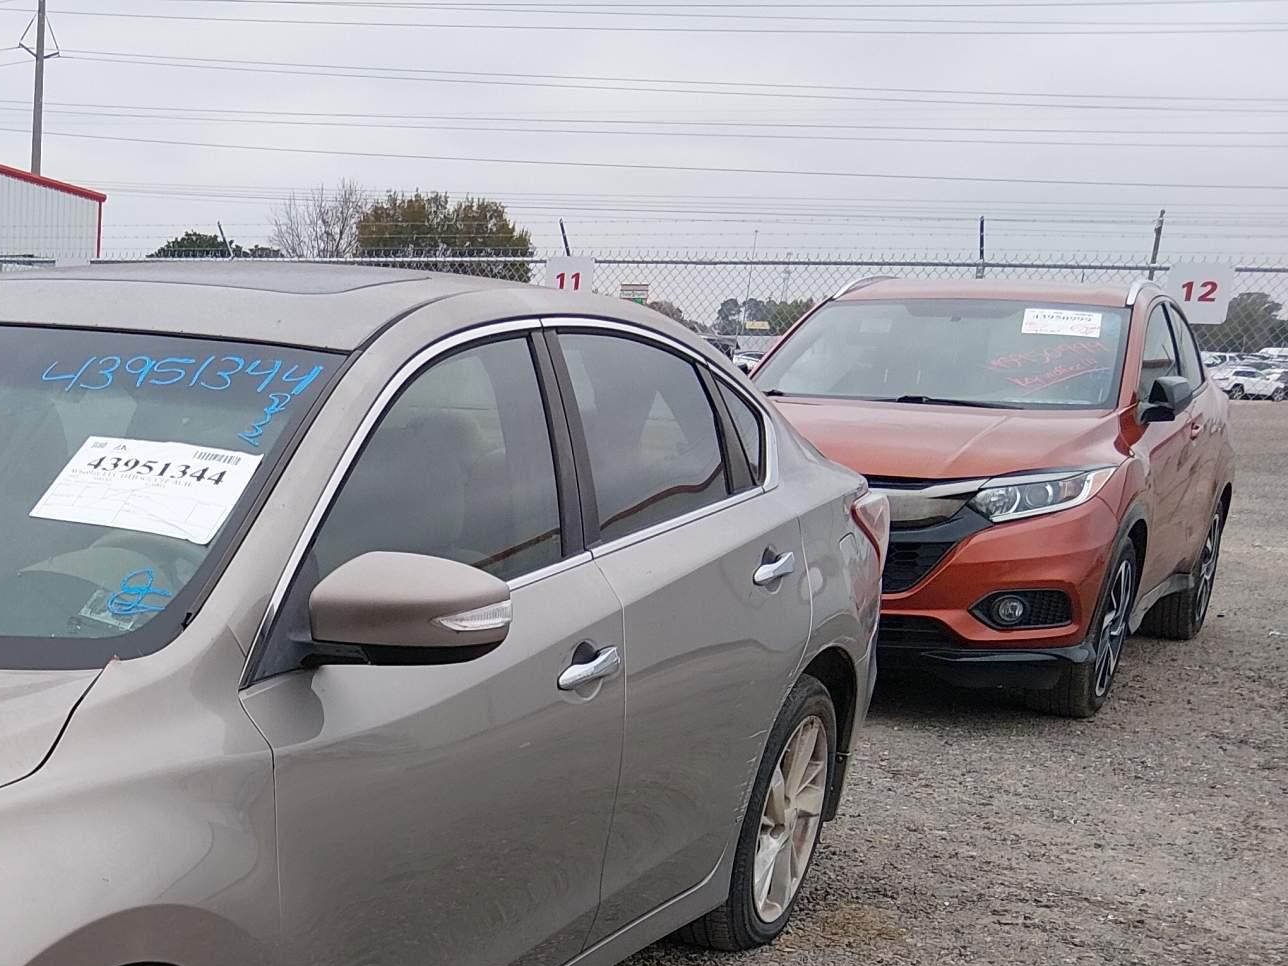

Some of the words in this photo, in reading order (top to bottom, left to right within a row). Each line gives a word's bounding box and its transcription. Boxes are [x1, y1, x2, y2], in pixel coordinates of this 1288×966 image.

[556, 272, 581, 291] 11
[1182, 280, 1219, 302] 12
[41, 355, 324, 394] 43951344
[87, 456, 228, 485] 43951344
